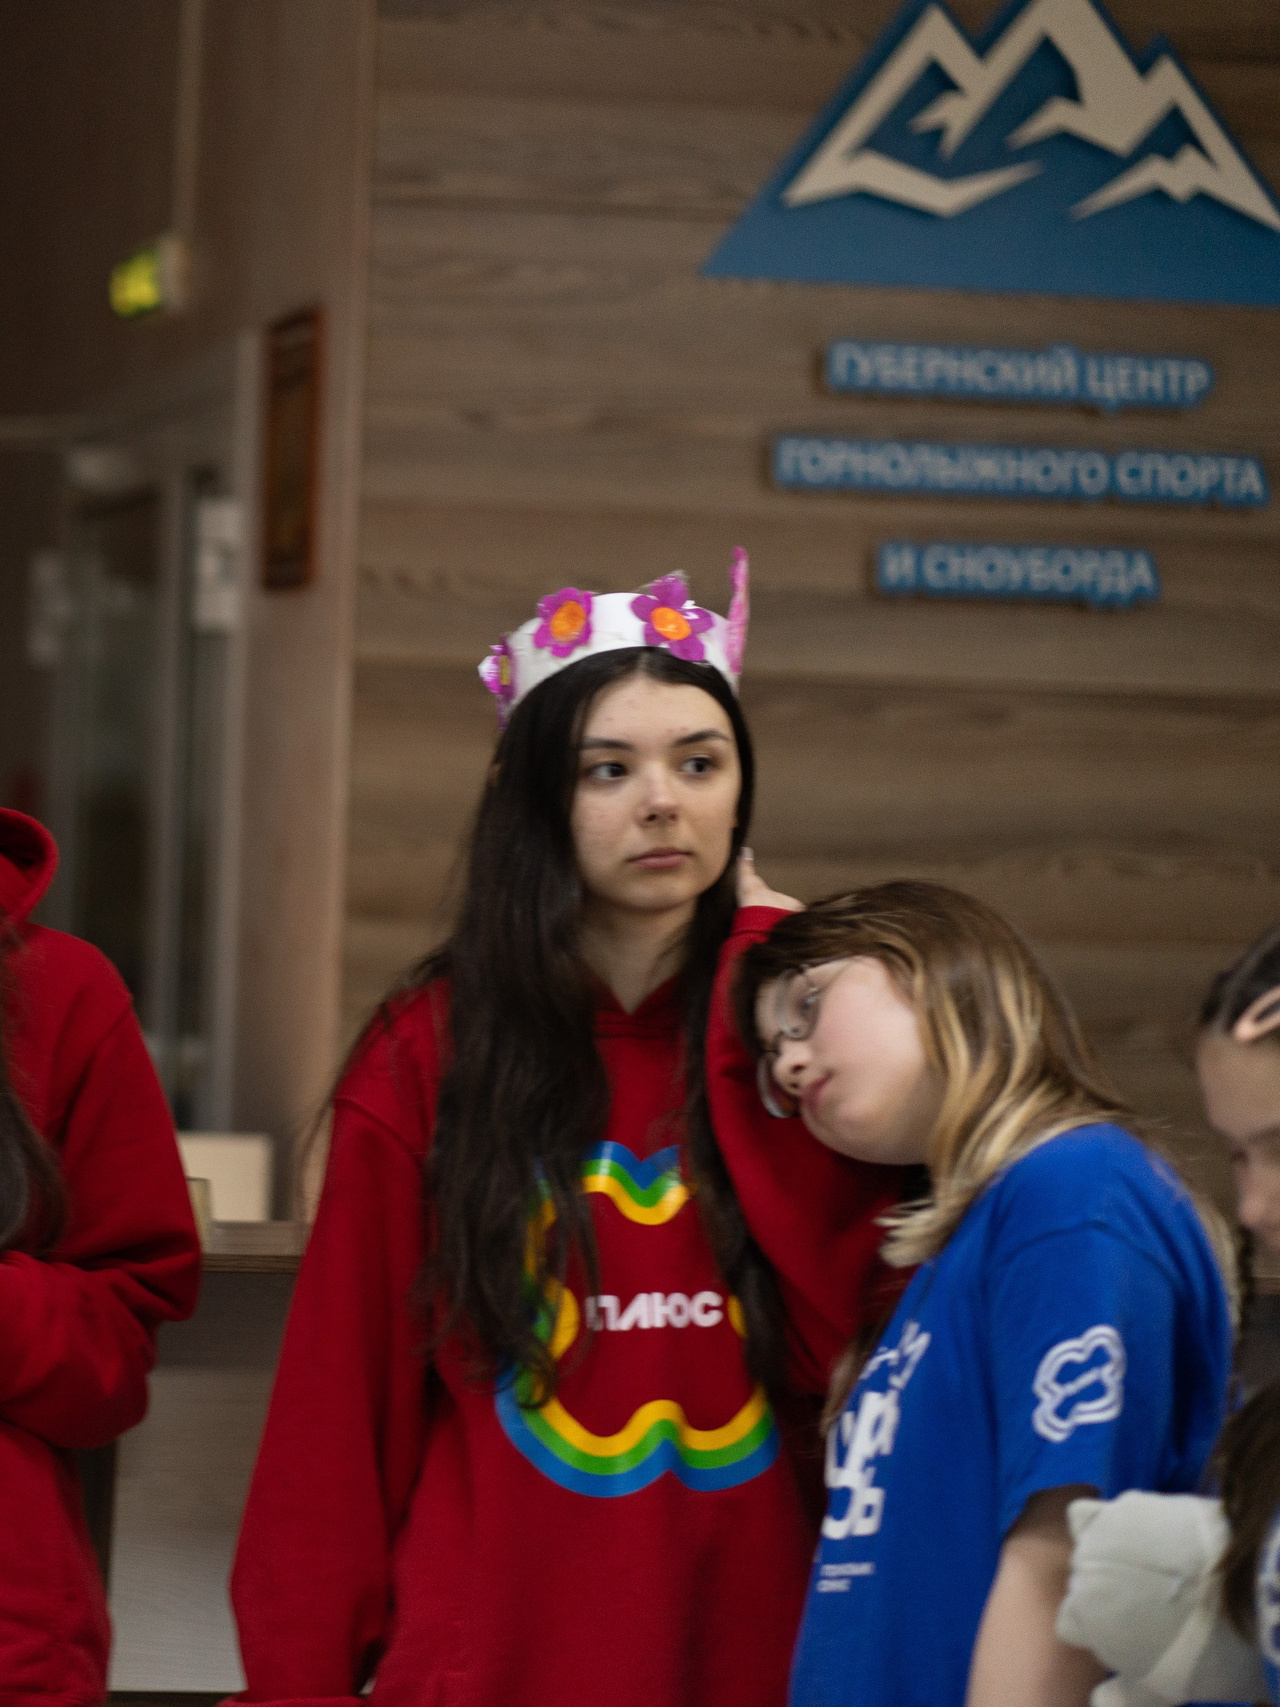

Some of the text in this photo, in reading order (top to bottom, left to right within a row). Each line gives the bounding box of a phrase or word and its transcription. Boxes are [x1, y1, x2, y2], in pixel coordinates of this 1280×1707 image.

[831, 342, 1210, 404] ГУБЕРНСКИЙ ЦЕНТР
[776, 438, 1263, 501] ГОРНОЛЫЖНОГО СПОРТА
[882, 545, 1155, 600] И СНОУБОРДА
[585, 1291, 723, 1331] ПЛЮС
